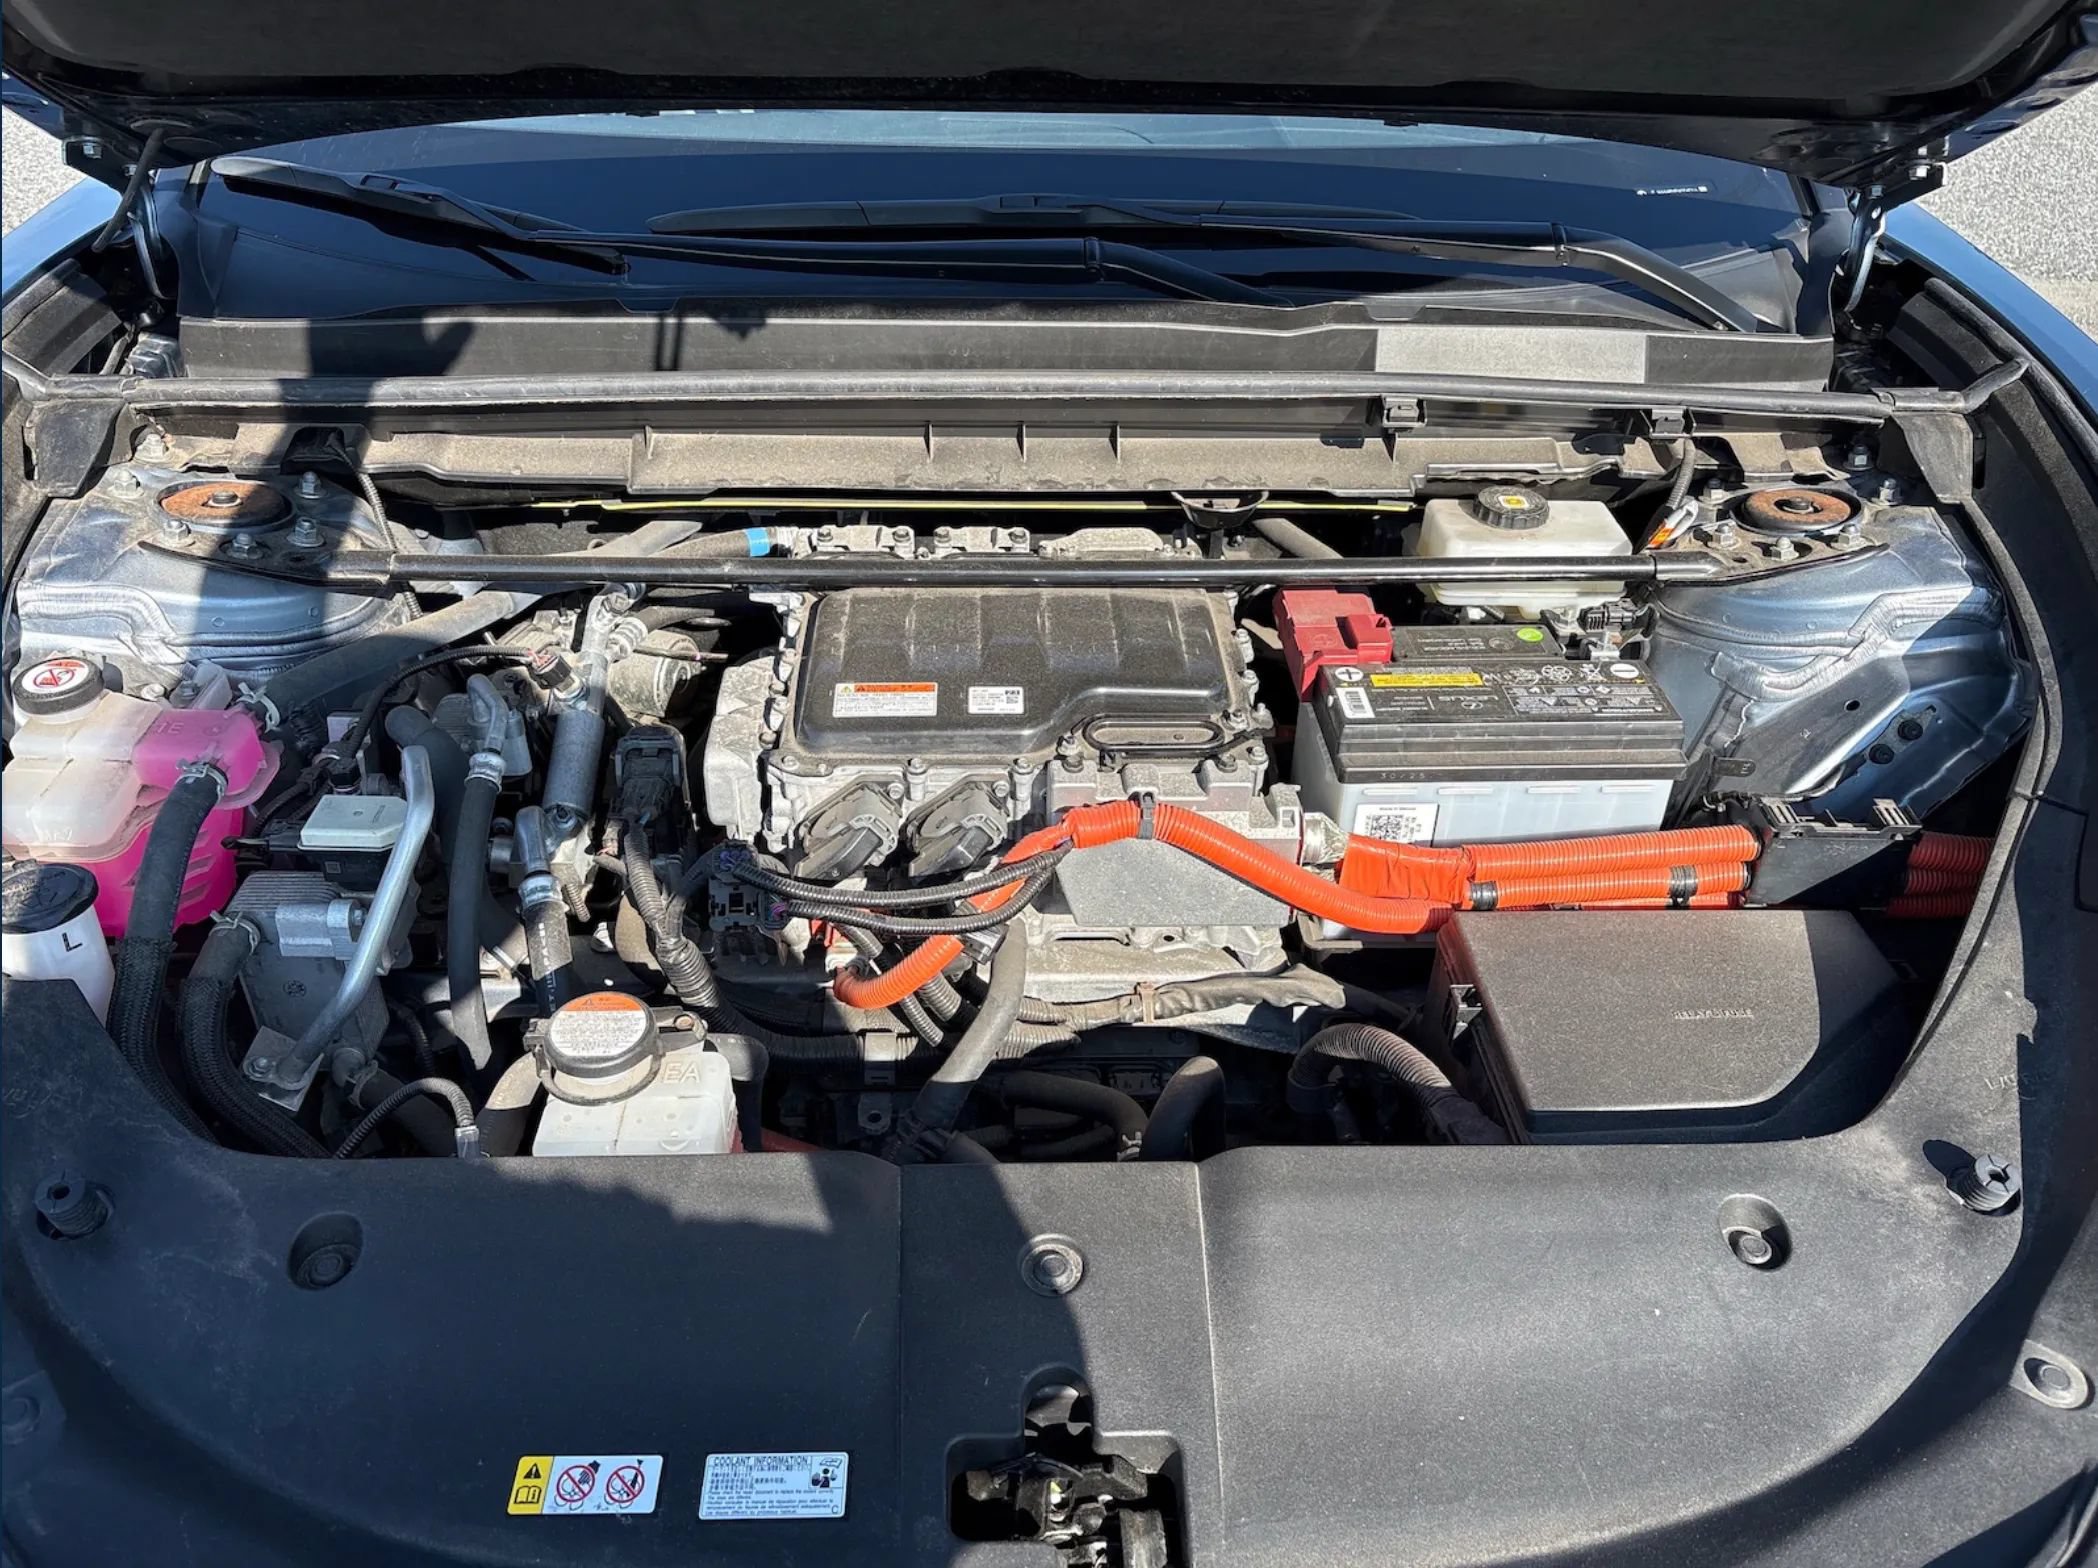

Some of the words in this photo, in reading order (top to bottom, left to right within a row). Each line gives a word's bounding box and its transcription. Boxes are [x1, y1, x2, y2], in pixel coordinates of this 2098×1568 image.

[61, 932, 83, 952] L
[662, 1060, 702, 1084] EA
[714, 1456, 751, 1467] COOLANT
[753, 1456, 808, 1466] INFORMATION
[831, 1504, 839, 1514] C
